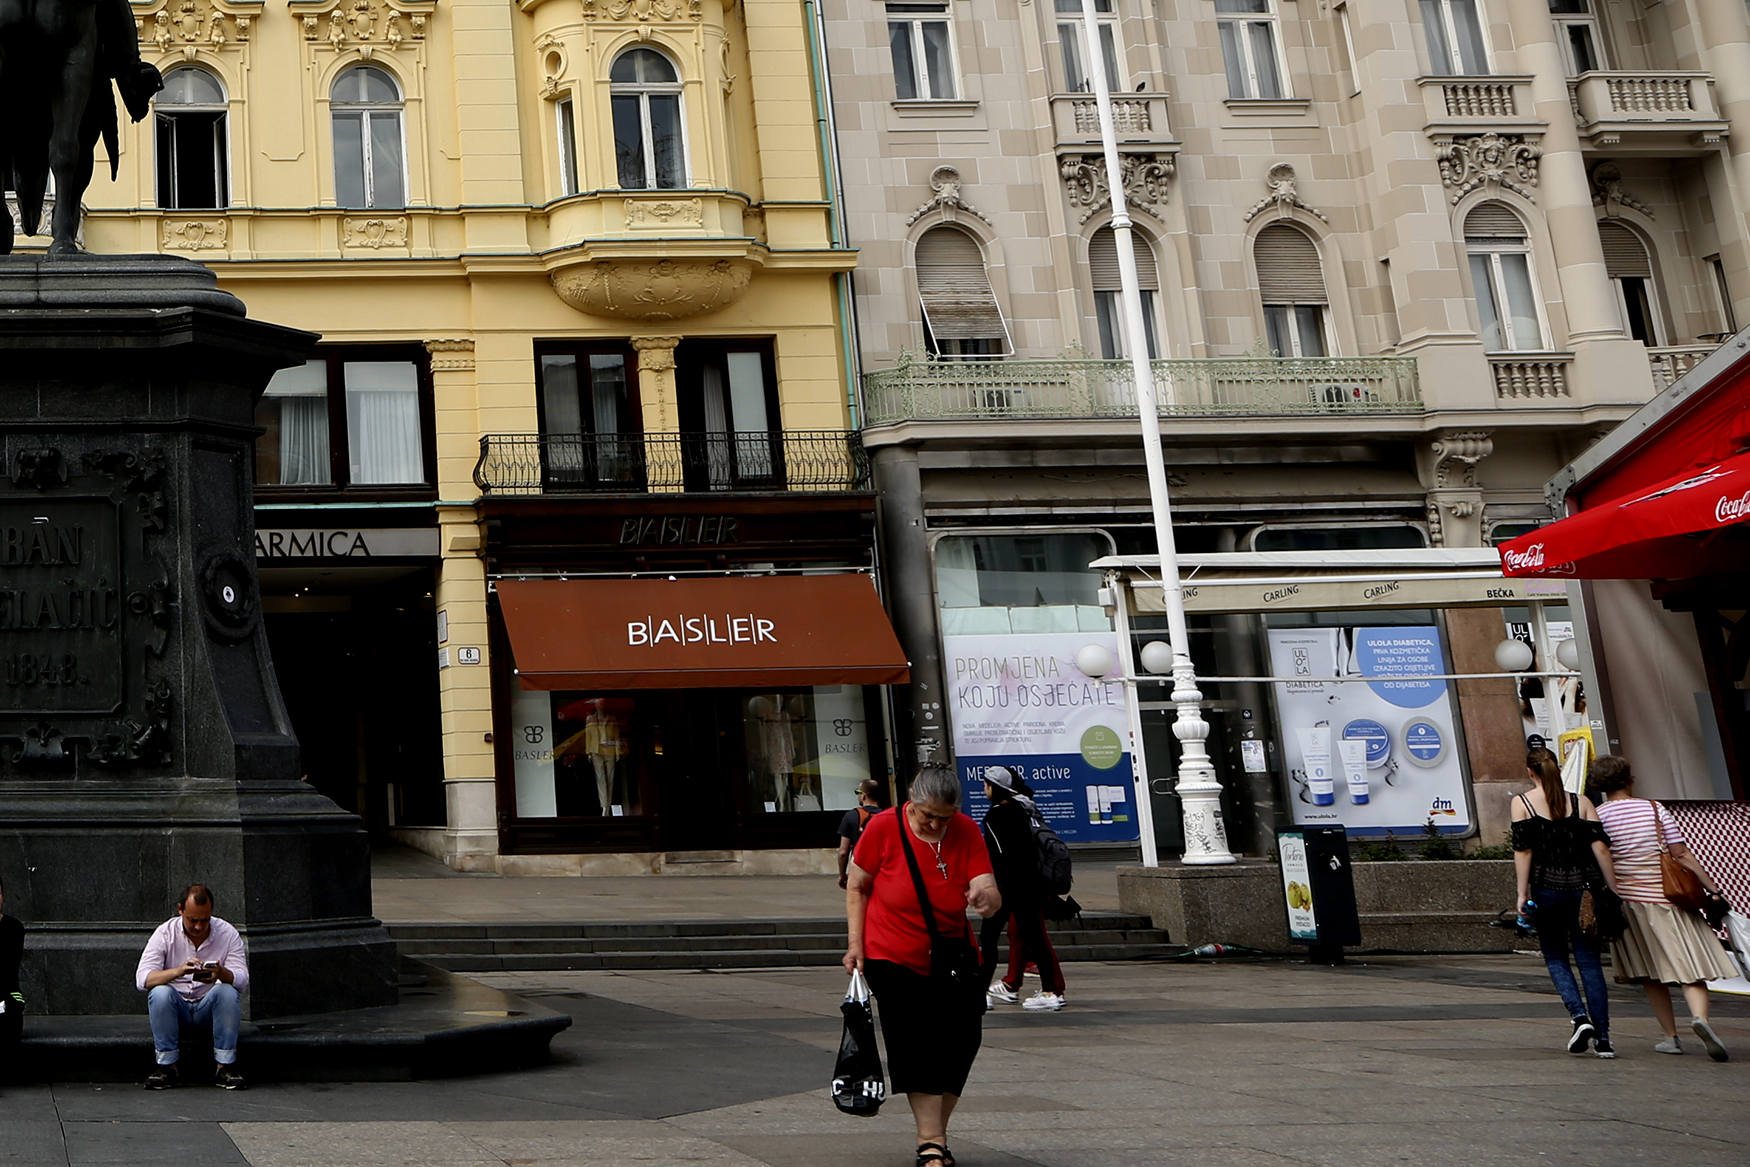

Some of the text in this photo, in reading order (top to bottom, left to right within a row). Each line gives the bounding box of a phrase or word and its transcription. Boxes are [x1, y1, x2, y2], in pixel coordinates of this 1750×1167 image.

[0, 525, 83, 568] BAN
[255, 531, 371, 556] ARMICA
[1263, 585, 1299, 602] CARLING
[1364, 580, 1399, 599] CARLING
[1486, 588, 1515, 598] BEČKA
[466, 649, 472, 659] 6
[955, 655, 1061, 681] PROMJENA
[958, 681, 1116, 709] KOJU OSJEĆATE
[825, 743, 866, 754] BASLER
[1032, 765, 1071, 780] active
[1432, 797, 1452, 809] dm
